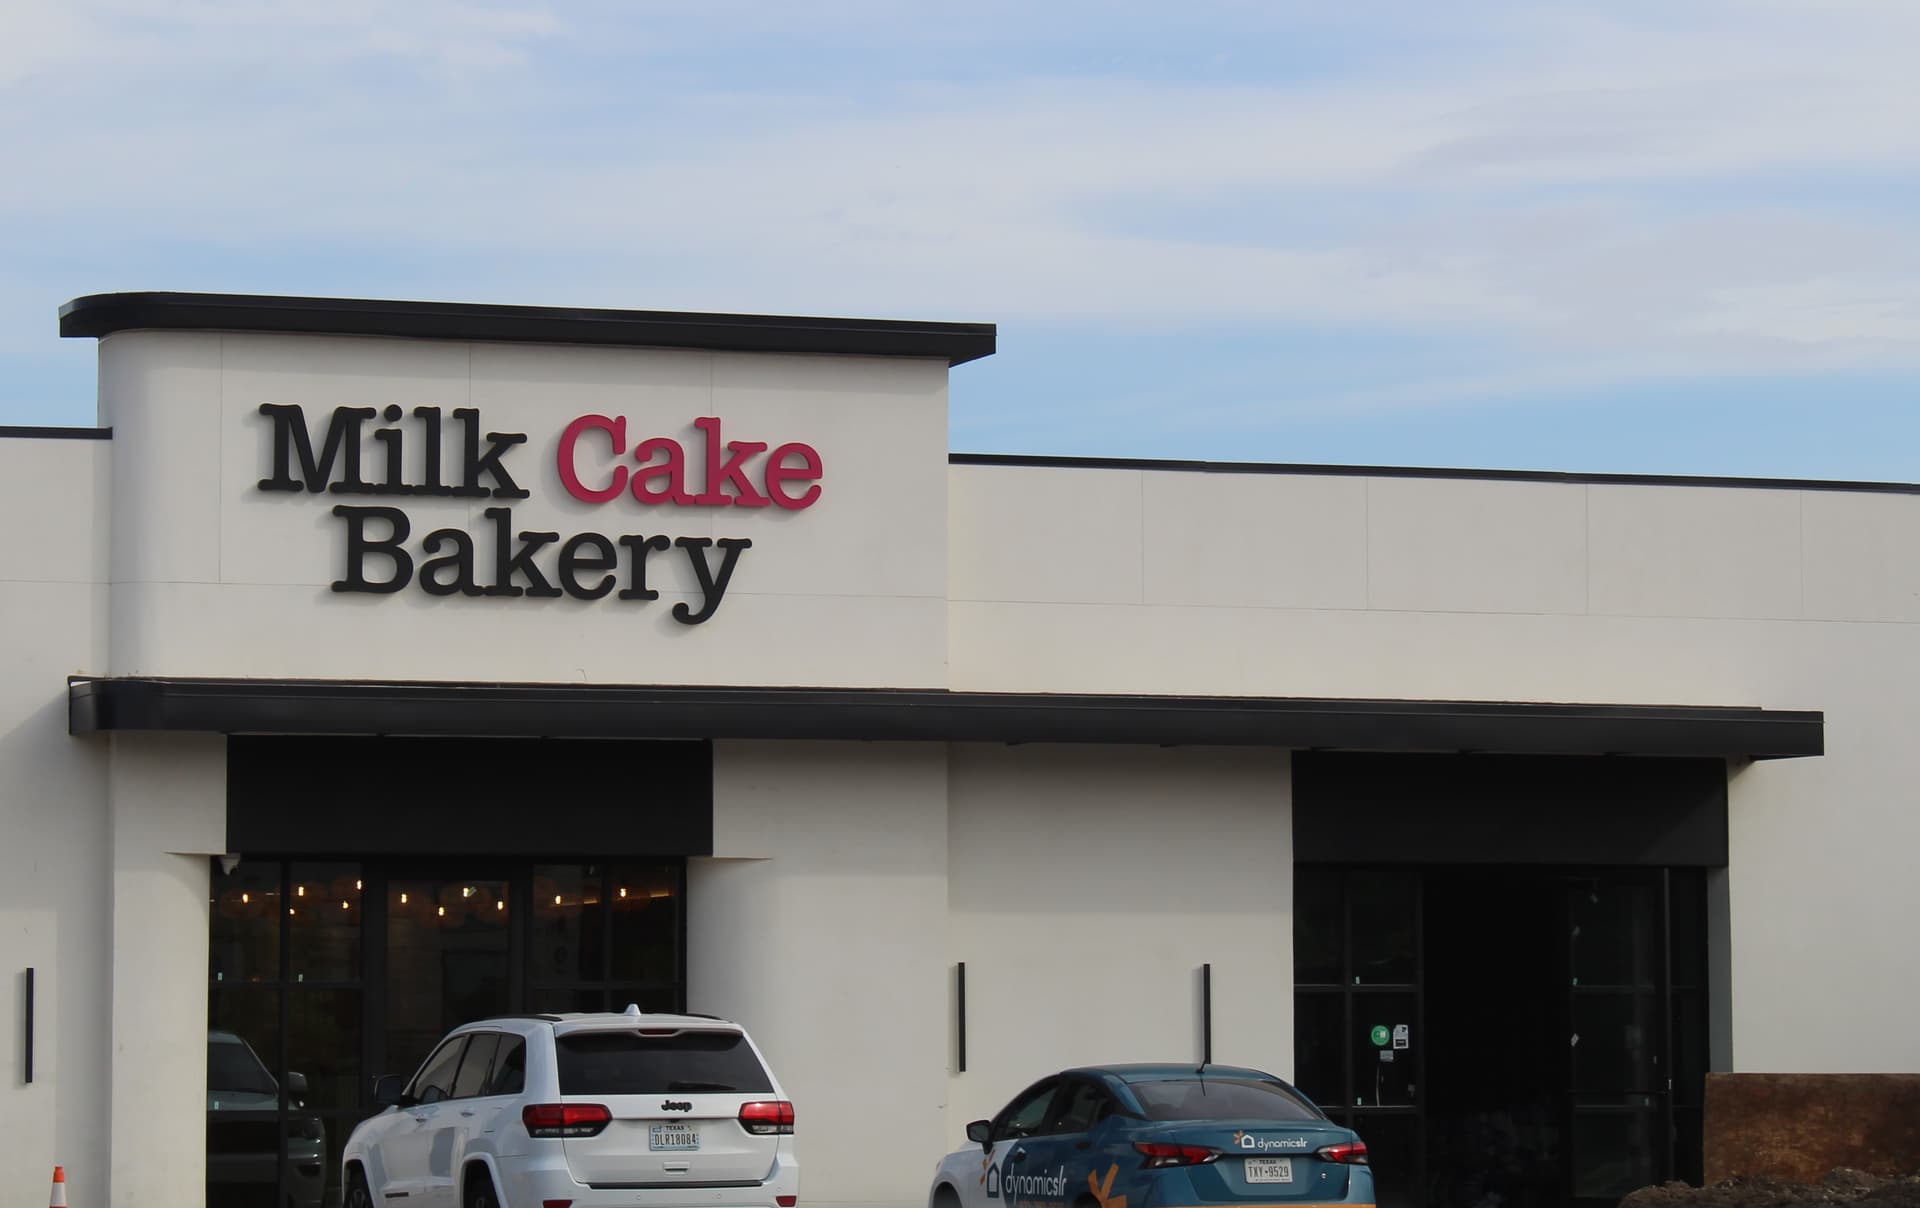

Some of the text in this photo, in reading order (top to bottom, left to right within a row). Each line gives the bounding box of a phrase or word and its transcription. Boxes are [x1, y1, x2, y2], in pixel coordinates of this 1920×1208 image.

[257, 403, 823, 510] Milk Cake
[331, 504, 753, 625] Bakery
[661, 1100, 692, 1112] Jeep
[1257, 1137, 1307, 1151] dynamicslr
[1006, 1163, 1067, 1206] dynamicslr
